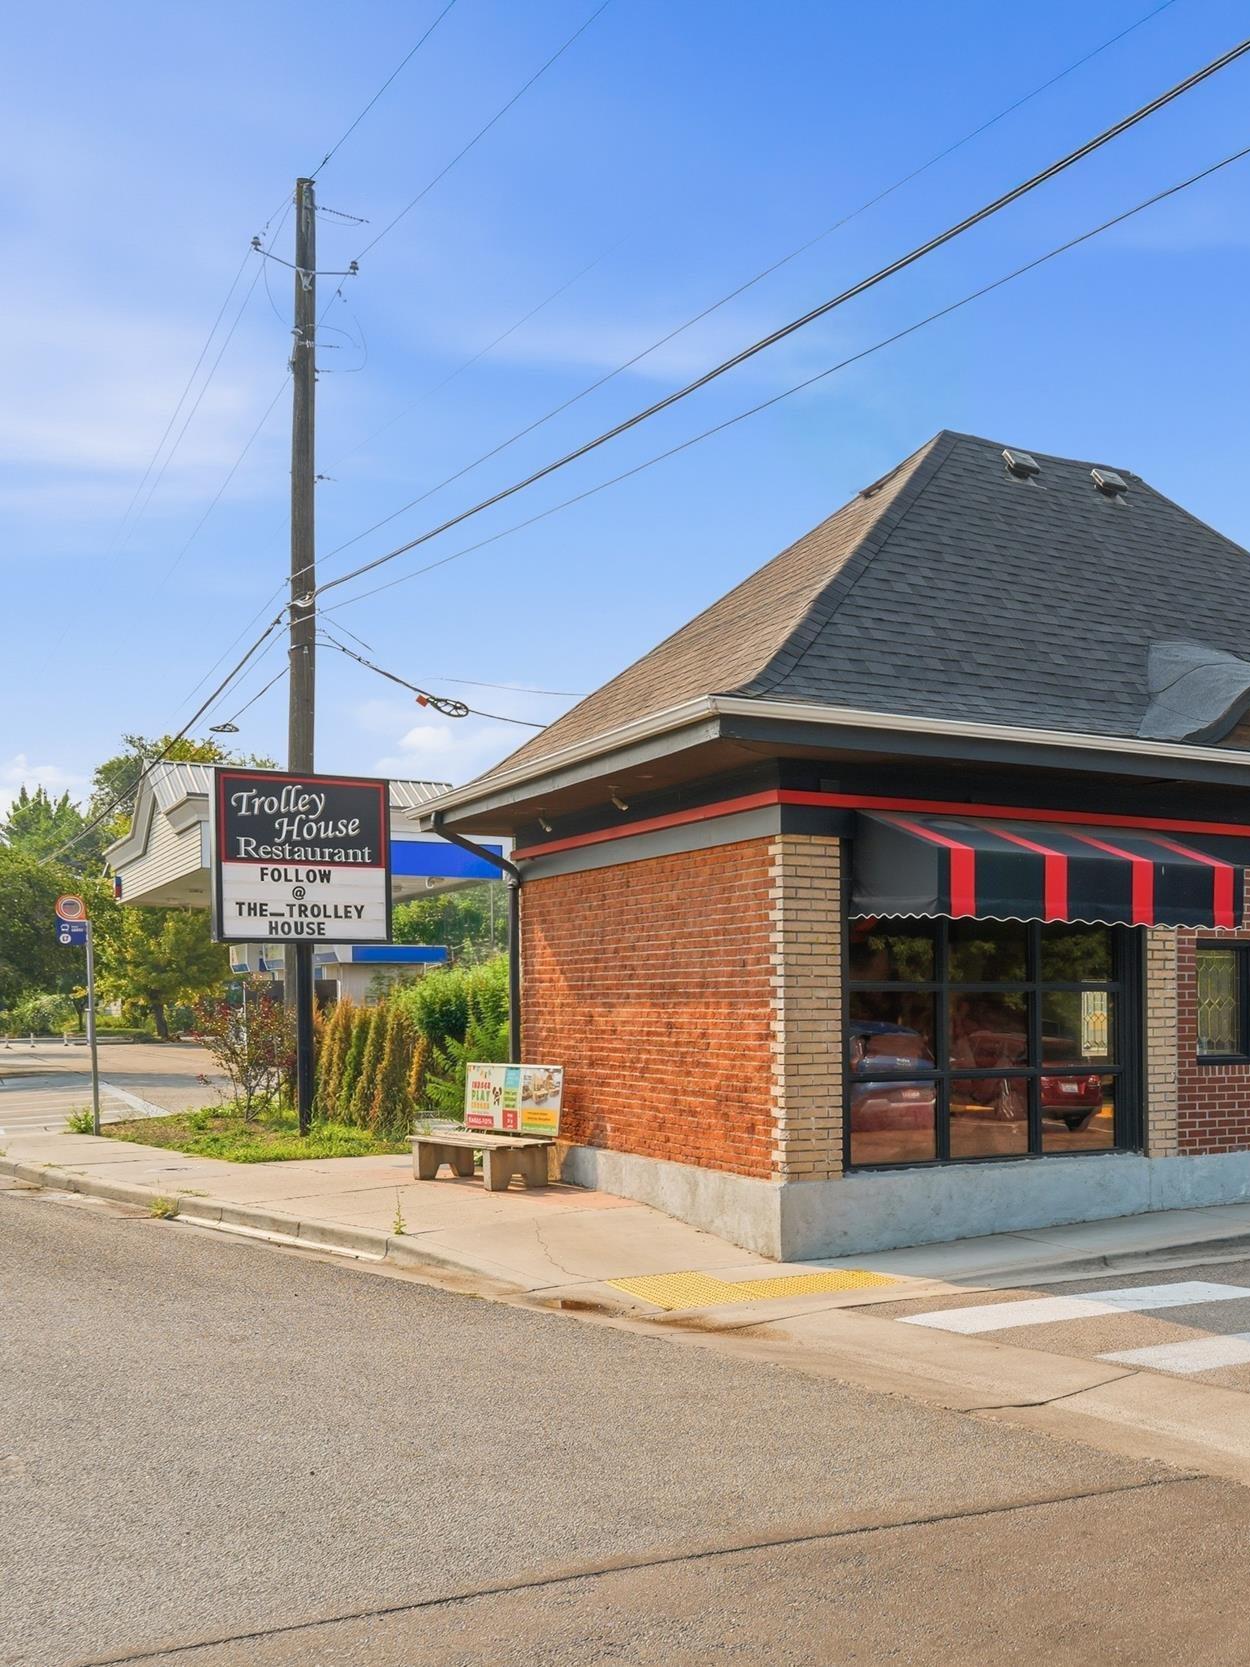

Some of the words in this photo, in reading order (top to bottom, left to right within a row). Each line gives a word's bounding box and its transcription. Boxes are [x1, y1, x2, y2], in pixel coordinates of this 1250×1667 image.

[231, 785, 325, 819] Trolley
[274, 814, 361, 843] House
[236, 836, 372, 863] Restaurant
[260, 867, 332, 884] FOLLOW
[292, 886, 306, 900] @
[268, 921, 326, 936] HOUSE
